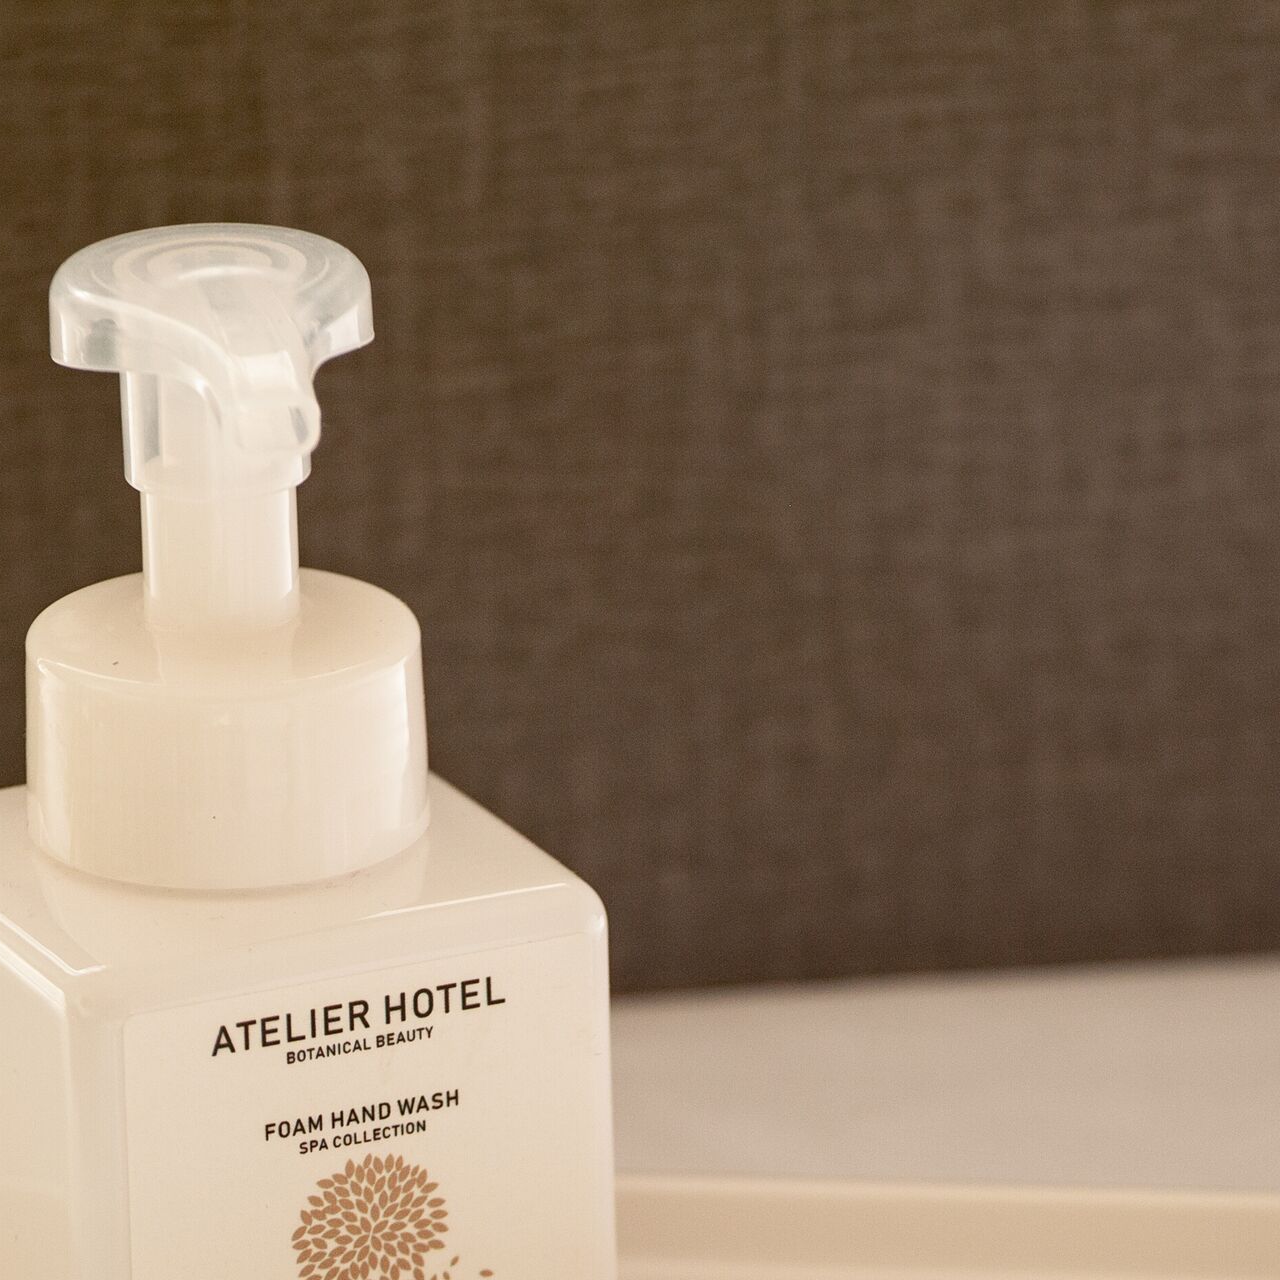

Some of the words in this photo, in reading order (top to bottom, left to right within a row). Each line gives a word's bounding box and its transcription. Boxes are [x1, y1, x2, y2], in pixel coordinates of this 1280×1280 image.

[211, 1000, 370, 1057] ATELIER
[384, 976, 506, 1025] HOTEL
[286, 1040, 371, 1065] BOTANICAL
[376, 1026, 434, 1048] BEAUTY
[265, 1114, 324, 1141] FOAM
[331, 1102, 391, 1130] HAND
[397, 1089, 460, 1116] WASH
[299, 1138, 329, 1155] SPA
[332, 1120, 427, 1149] COLLECTION
